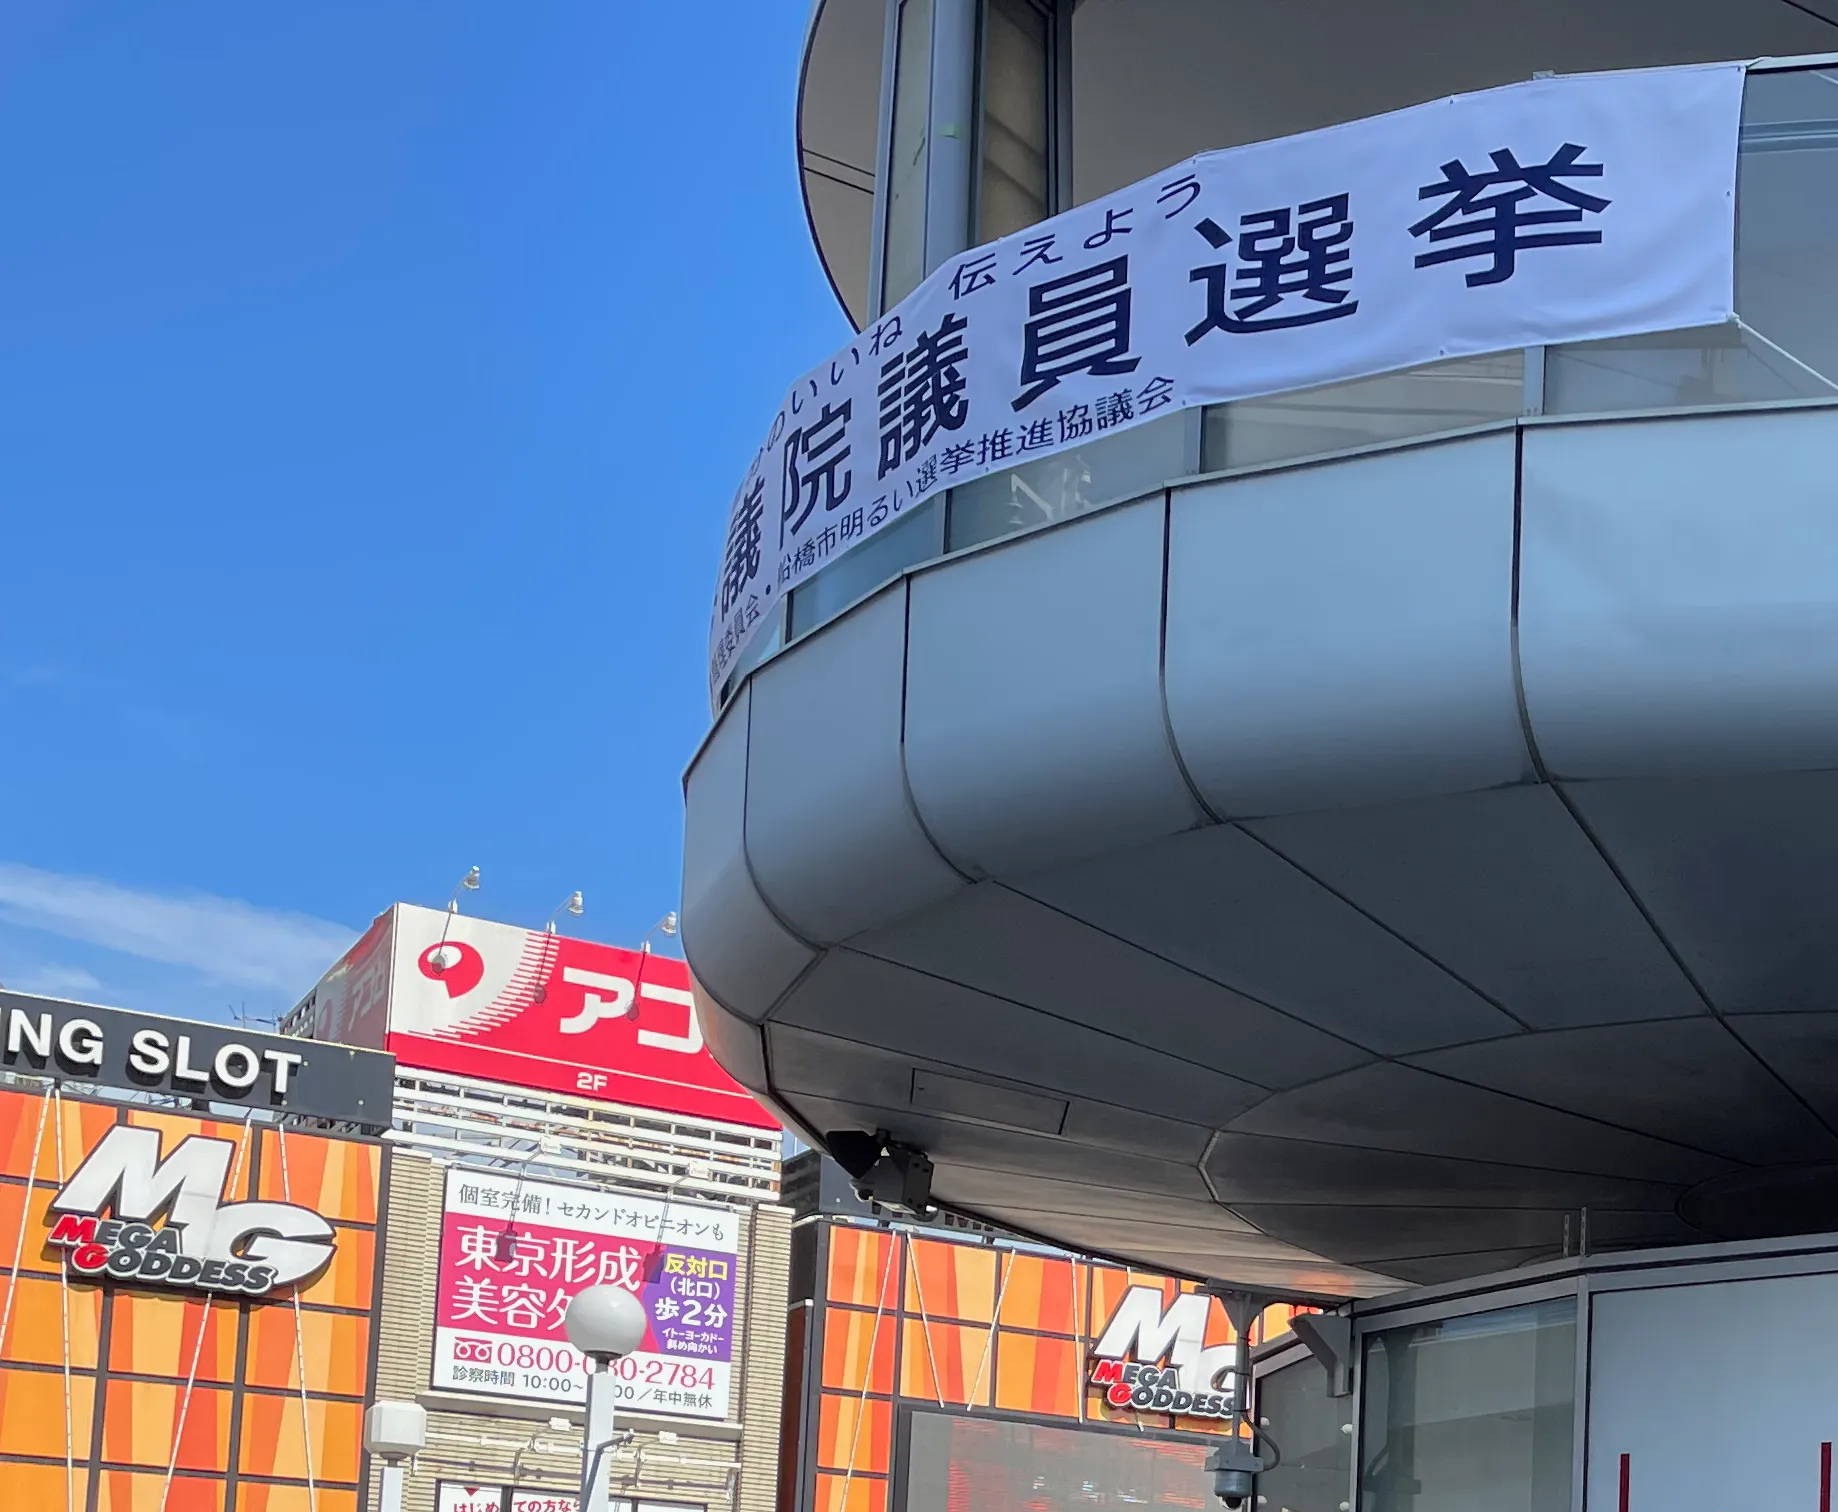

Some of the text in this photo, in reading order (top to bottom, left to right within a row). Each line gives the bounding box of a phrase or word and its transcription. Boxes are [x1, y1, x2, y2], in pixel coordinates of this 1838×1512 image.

[947, 175, 1201, 302] 伝えよう
[713, 142, 1612, 635] 議院議員選挙
[0, 1007, 302, 1094] NG SLOT
[576, 1071, 608, 1091] 2F
[50, 1215, 181, 1256] MEGA
[72, 1245, 279, 1293] GODDESS
[455, 1225, 643, 1292] 東京形成
[664, 1253, 728, 1280] 反対口
[670, 1277, 721, 1300] (北口)
[655, 1299, 728, 1328] 歩2分
[662, 1327, 724, 1344] イトーヨーカドー
[666, 1340, 718, 1355] 斜め向かい
[452, 1365, 515, 1387] 診察時間
[1094, 1358, 1176, 1387] MEGA
[1108, 1383, 1237, 1419] GODDESS
